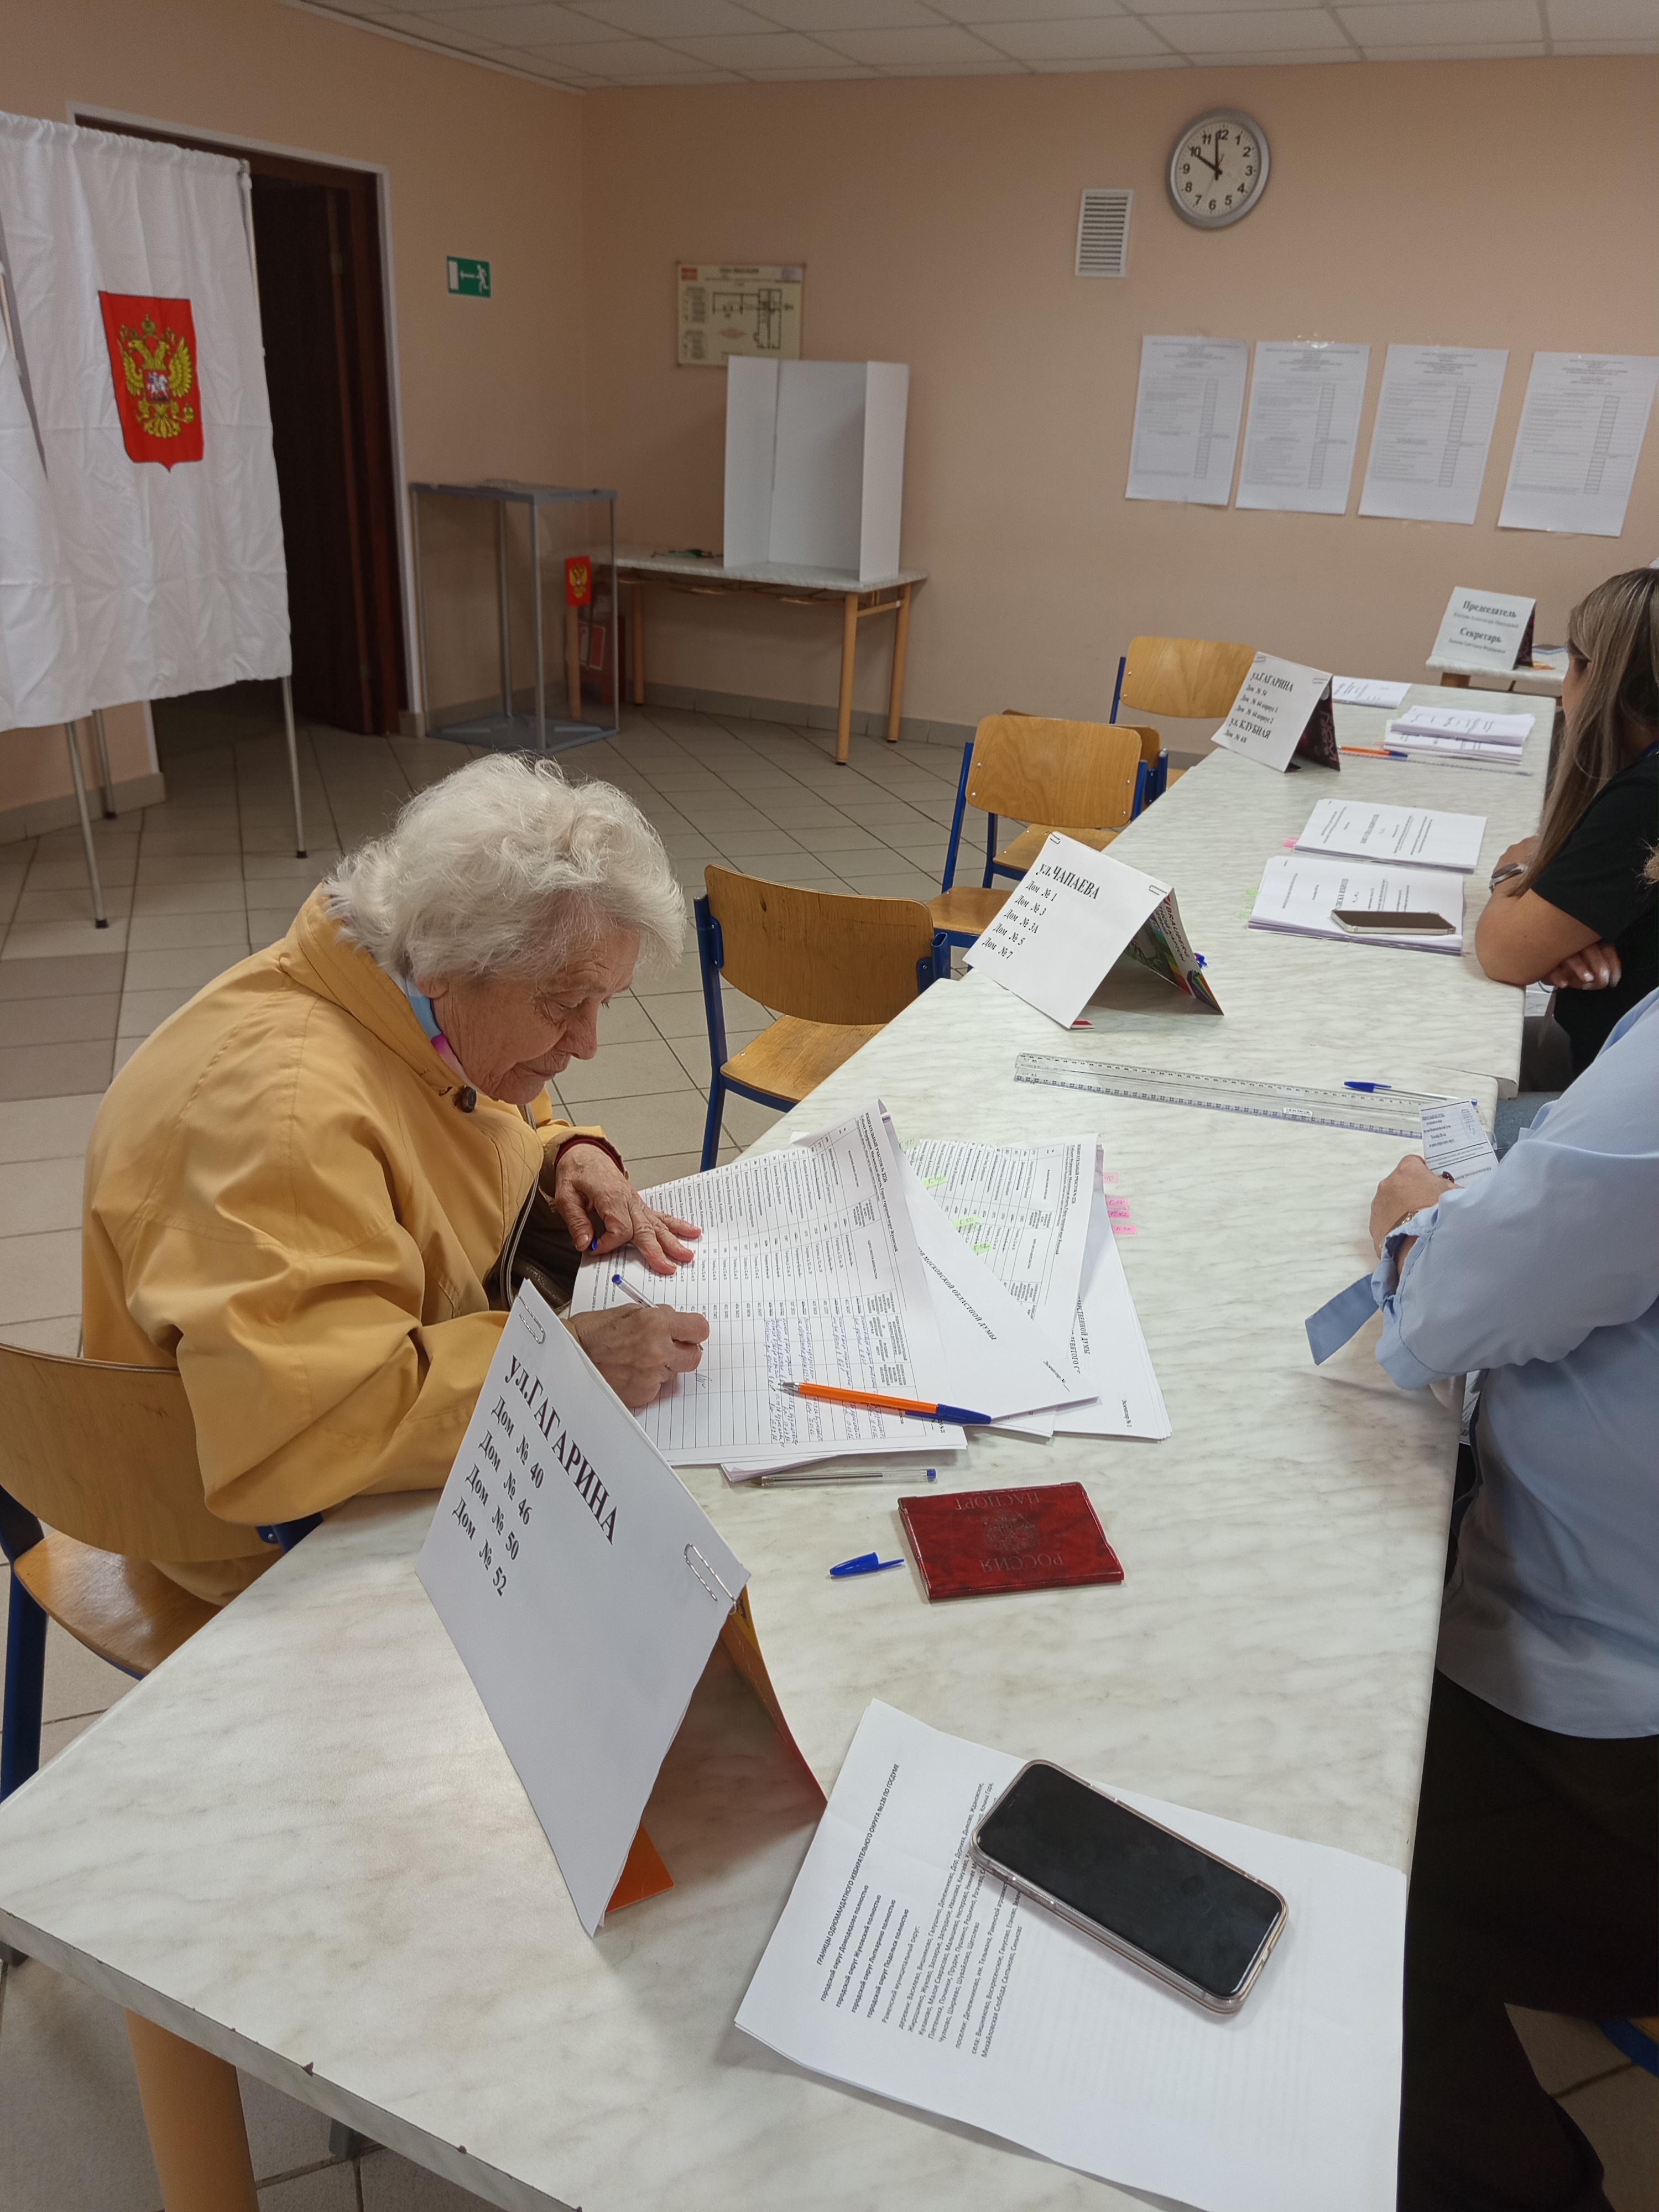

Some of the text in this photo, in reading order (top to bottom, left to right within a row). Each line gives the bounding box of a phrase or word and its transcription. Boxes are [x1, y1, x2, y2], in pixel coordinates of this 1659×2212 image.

[1203, 134, 1212, 144] 11
[1216, 129, 1229, 140] 12
[1235, 135, 1241, 145] 1
[1191, 147, 1201, 156] 10
[1243, 147, 1251, 157] 2
[1183, 164, 1190, 174] 9
[1245, 166, 1253, 176] 3
[1185, 182, 1192, 192] 8
[1237, 183, 1245, 193] 4
[1196, 195, 1202, 205] 7
[1209, 200, 1216, 210] 6
[1225, 195, 1232, 205] 5
[1239, 719, 1271, 738] КЛУБНАЯ
[1025, 880, 1057, 901] Дом № 1
[1015, 895, 1046, 916] Дом № 3
[1004, 909, 1018, 921] Дом
[1019, 917, 1029, 927] №
[993, 923, 1008, 936] Дом
[1009, 932, 1019, 942] №
[1166, 906, 1190, 958] BRAUBERG
[982, 937, 997, 950] Дом
[998, 946, 1008, 957] №
[923, 1256, 997, 1340] МОСКОВСКОЙ ОБЛАСТНОЙ ДУМЫ
[1081, 1333, 1090, 1354] ДУМЫ
[491, 1396, 544, 1488] Дом № 40
[478, 1430, 532, 1525] Дом № 46
[465, 1464, 519, 1560] Дом № 50
[452, 1497, 507, 1597] Дом № 52
[816, 1764, 899, 1965] ГРАНИЦЫ ОДНОМАНДАТНОГО ИЗБИРАТЕЛЬНОГО ОКРУГА №126 ПО ГОСДУМЕ
[997, 1881, 1009, 1907] агрохимст
[1012, 1890, 1023, 1907] Зелен
[821, 1885, 868, 2001] городской округ Домодедово полностью
[836, 1895, 881, 2007] городской округ Жуковский полностью
[852, 1900, 895, 2012] городской округ Лыткарино полностью
[867, 1909, 909, 2018] городской округ Подольск полностью
